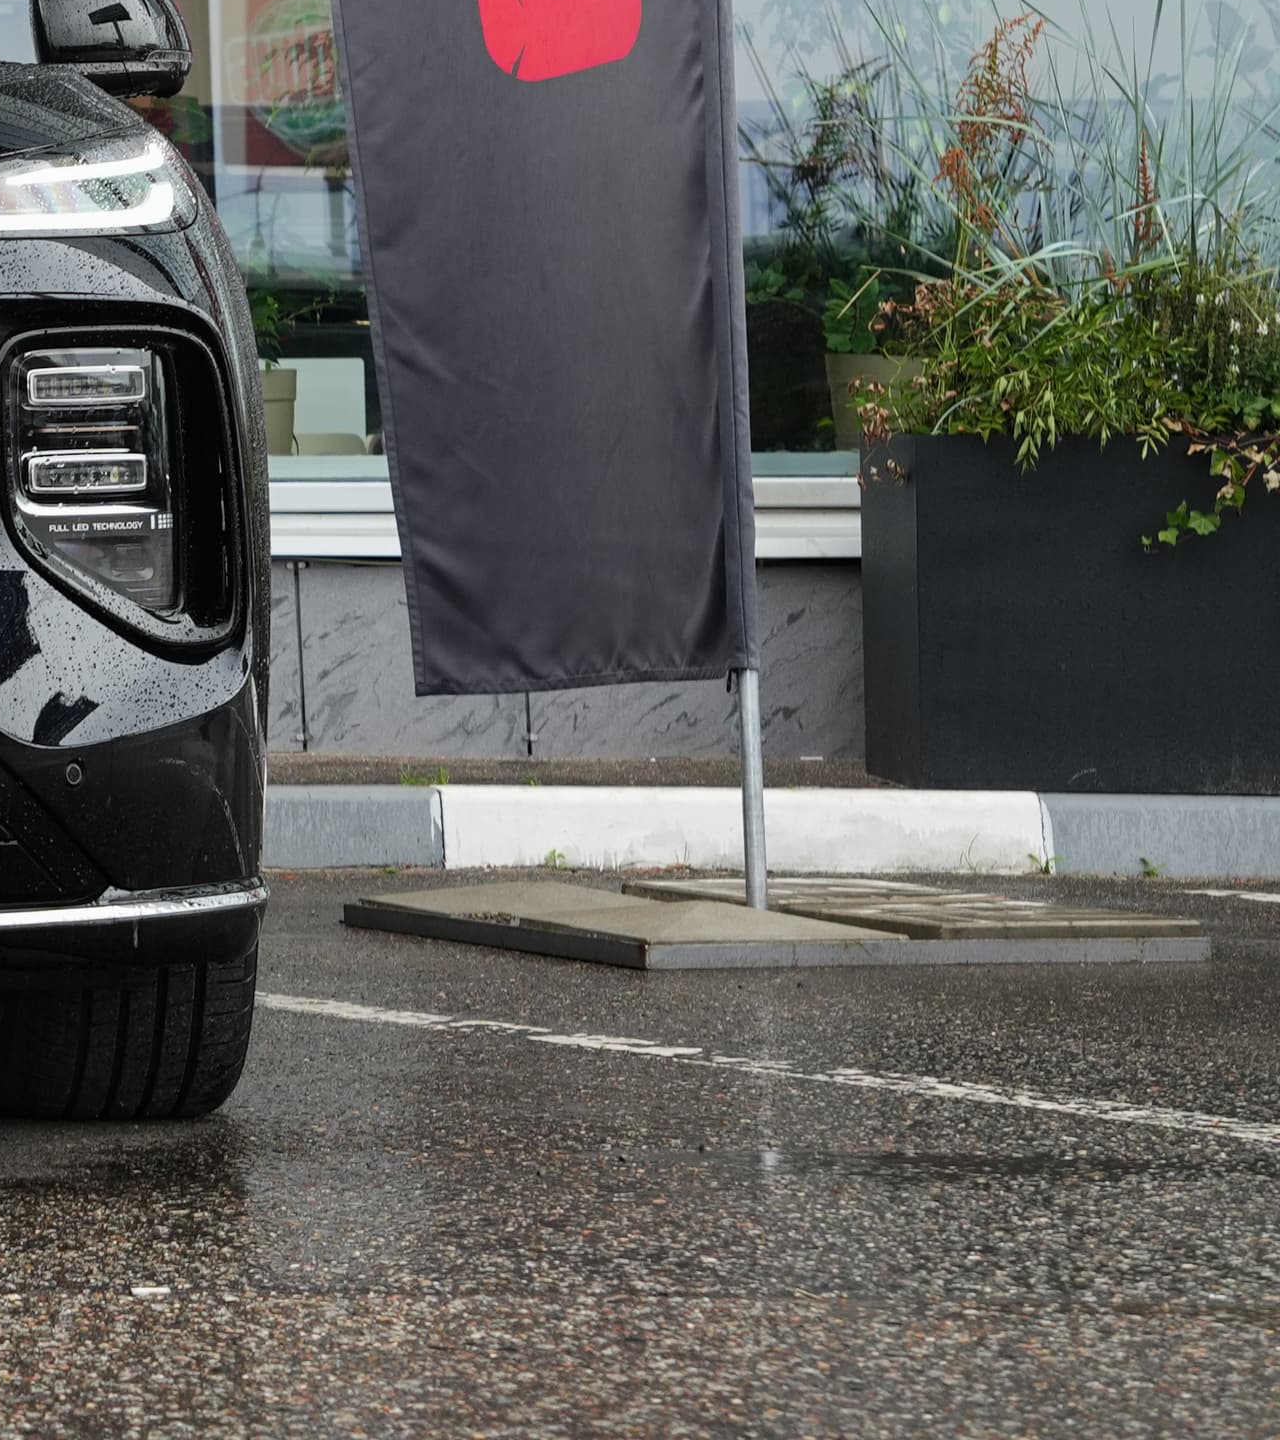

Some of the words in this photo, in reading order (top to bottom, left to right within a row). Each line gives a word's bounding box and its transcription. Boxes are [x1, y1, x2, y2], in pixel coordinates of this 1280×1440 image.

[49, 524, 70, 533] FULL
[72, 523, 89, 532] LED
[92, 521, 144, 531] TECHNOLOGY
